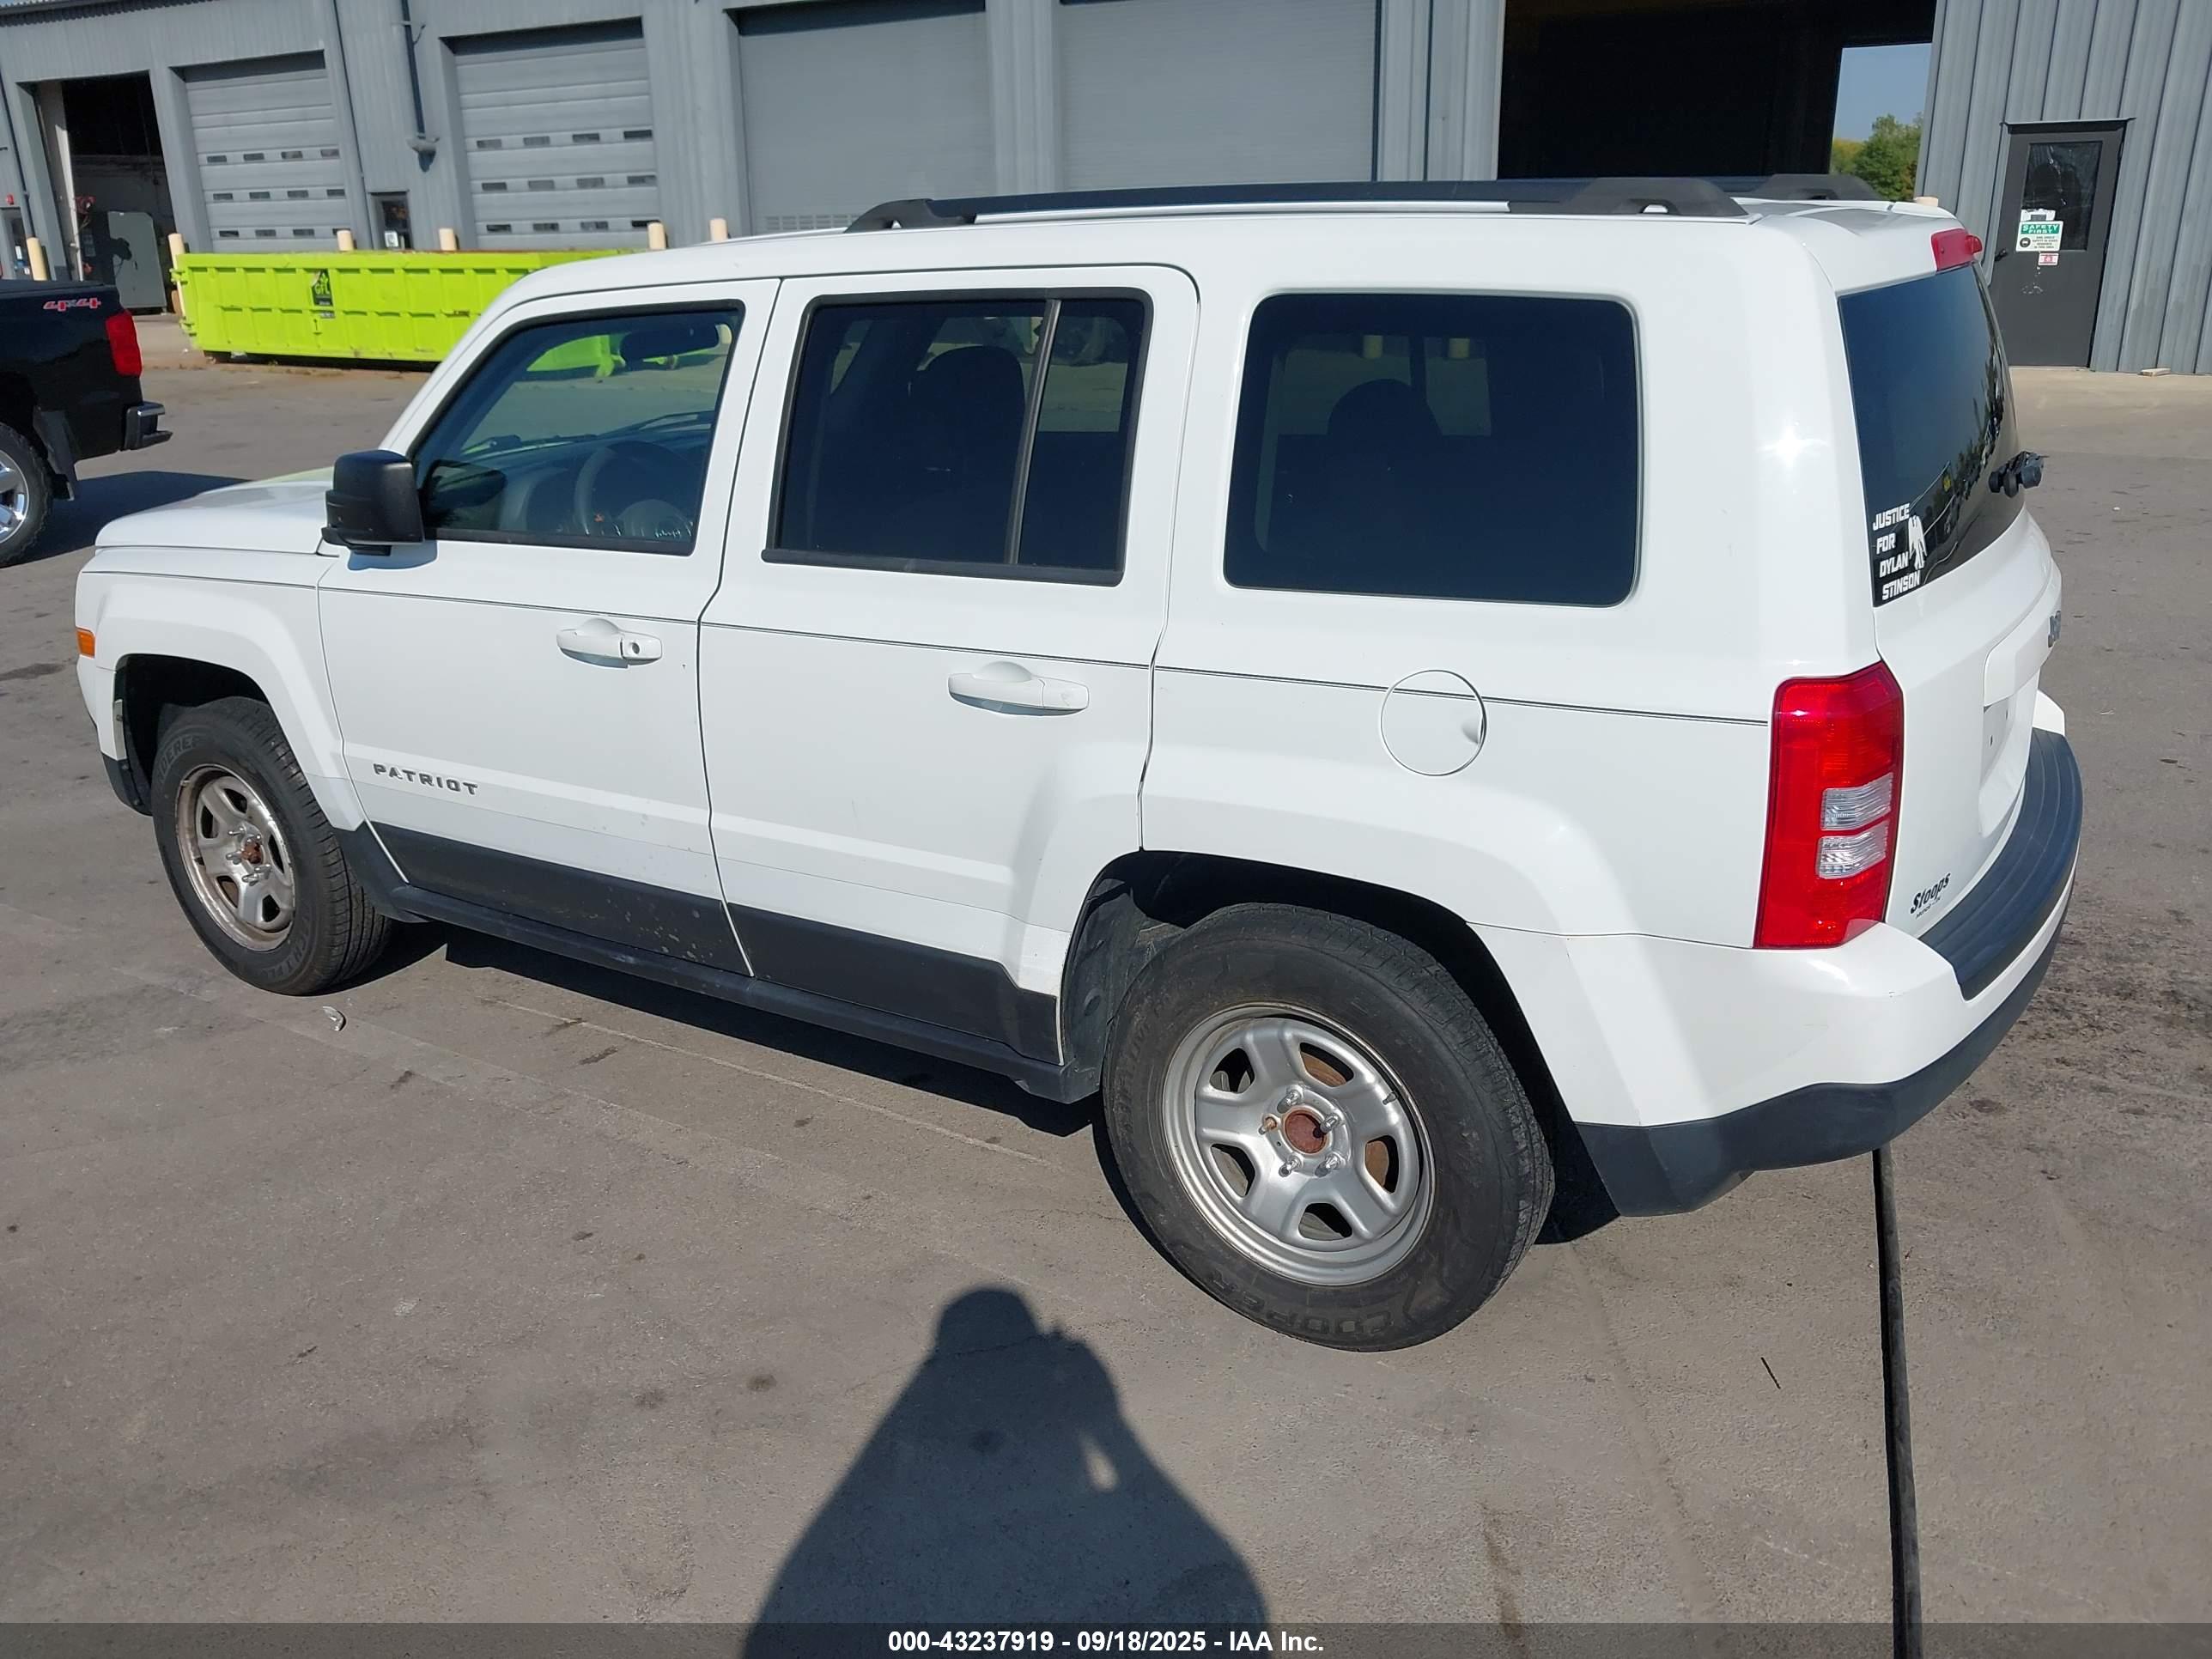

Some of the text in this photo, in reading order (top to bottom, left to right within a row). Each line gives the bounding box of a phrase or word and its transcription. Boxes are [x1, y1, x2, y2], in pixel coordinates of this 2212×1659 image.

[1873, 503, 1911, 531] JUSTICE
[1876, 533, 1896, 555] FOR
[1880, 551, 1909, 577] DYLAN
[1881, 570, 1921, 601] STINSON
[373, 763, 479, 795] PATRIOT
[1910, 872, 1951, 915] Stoops
